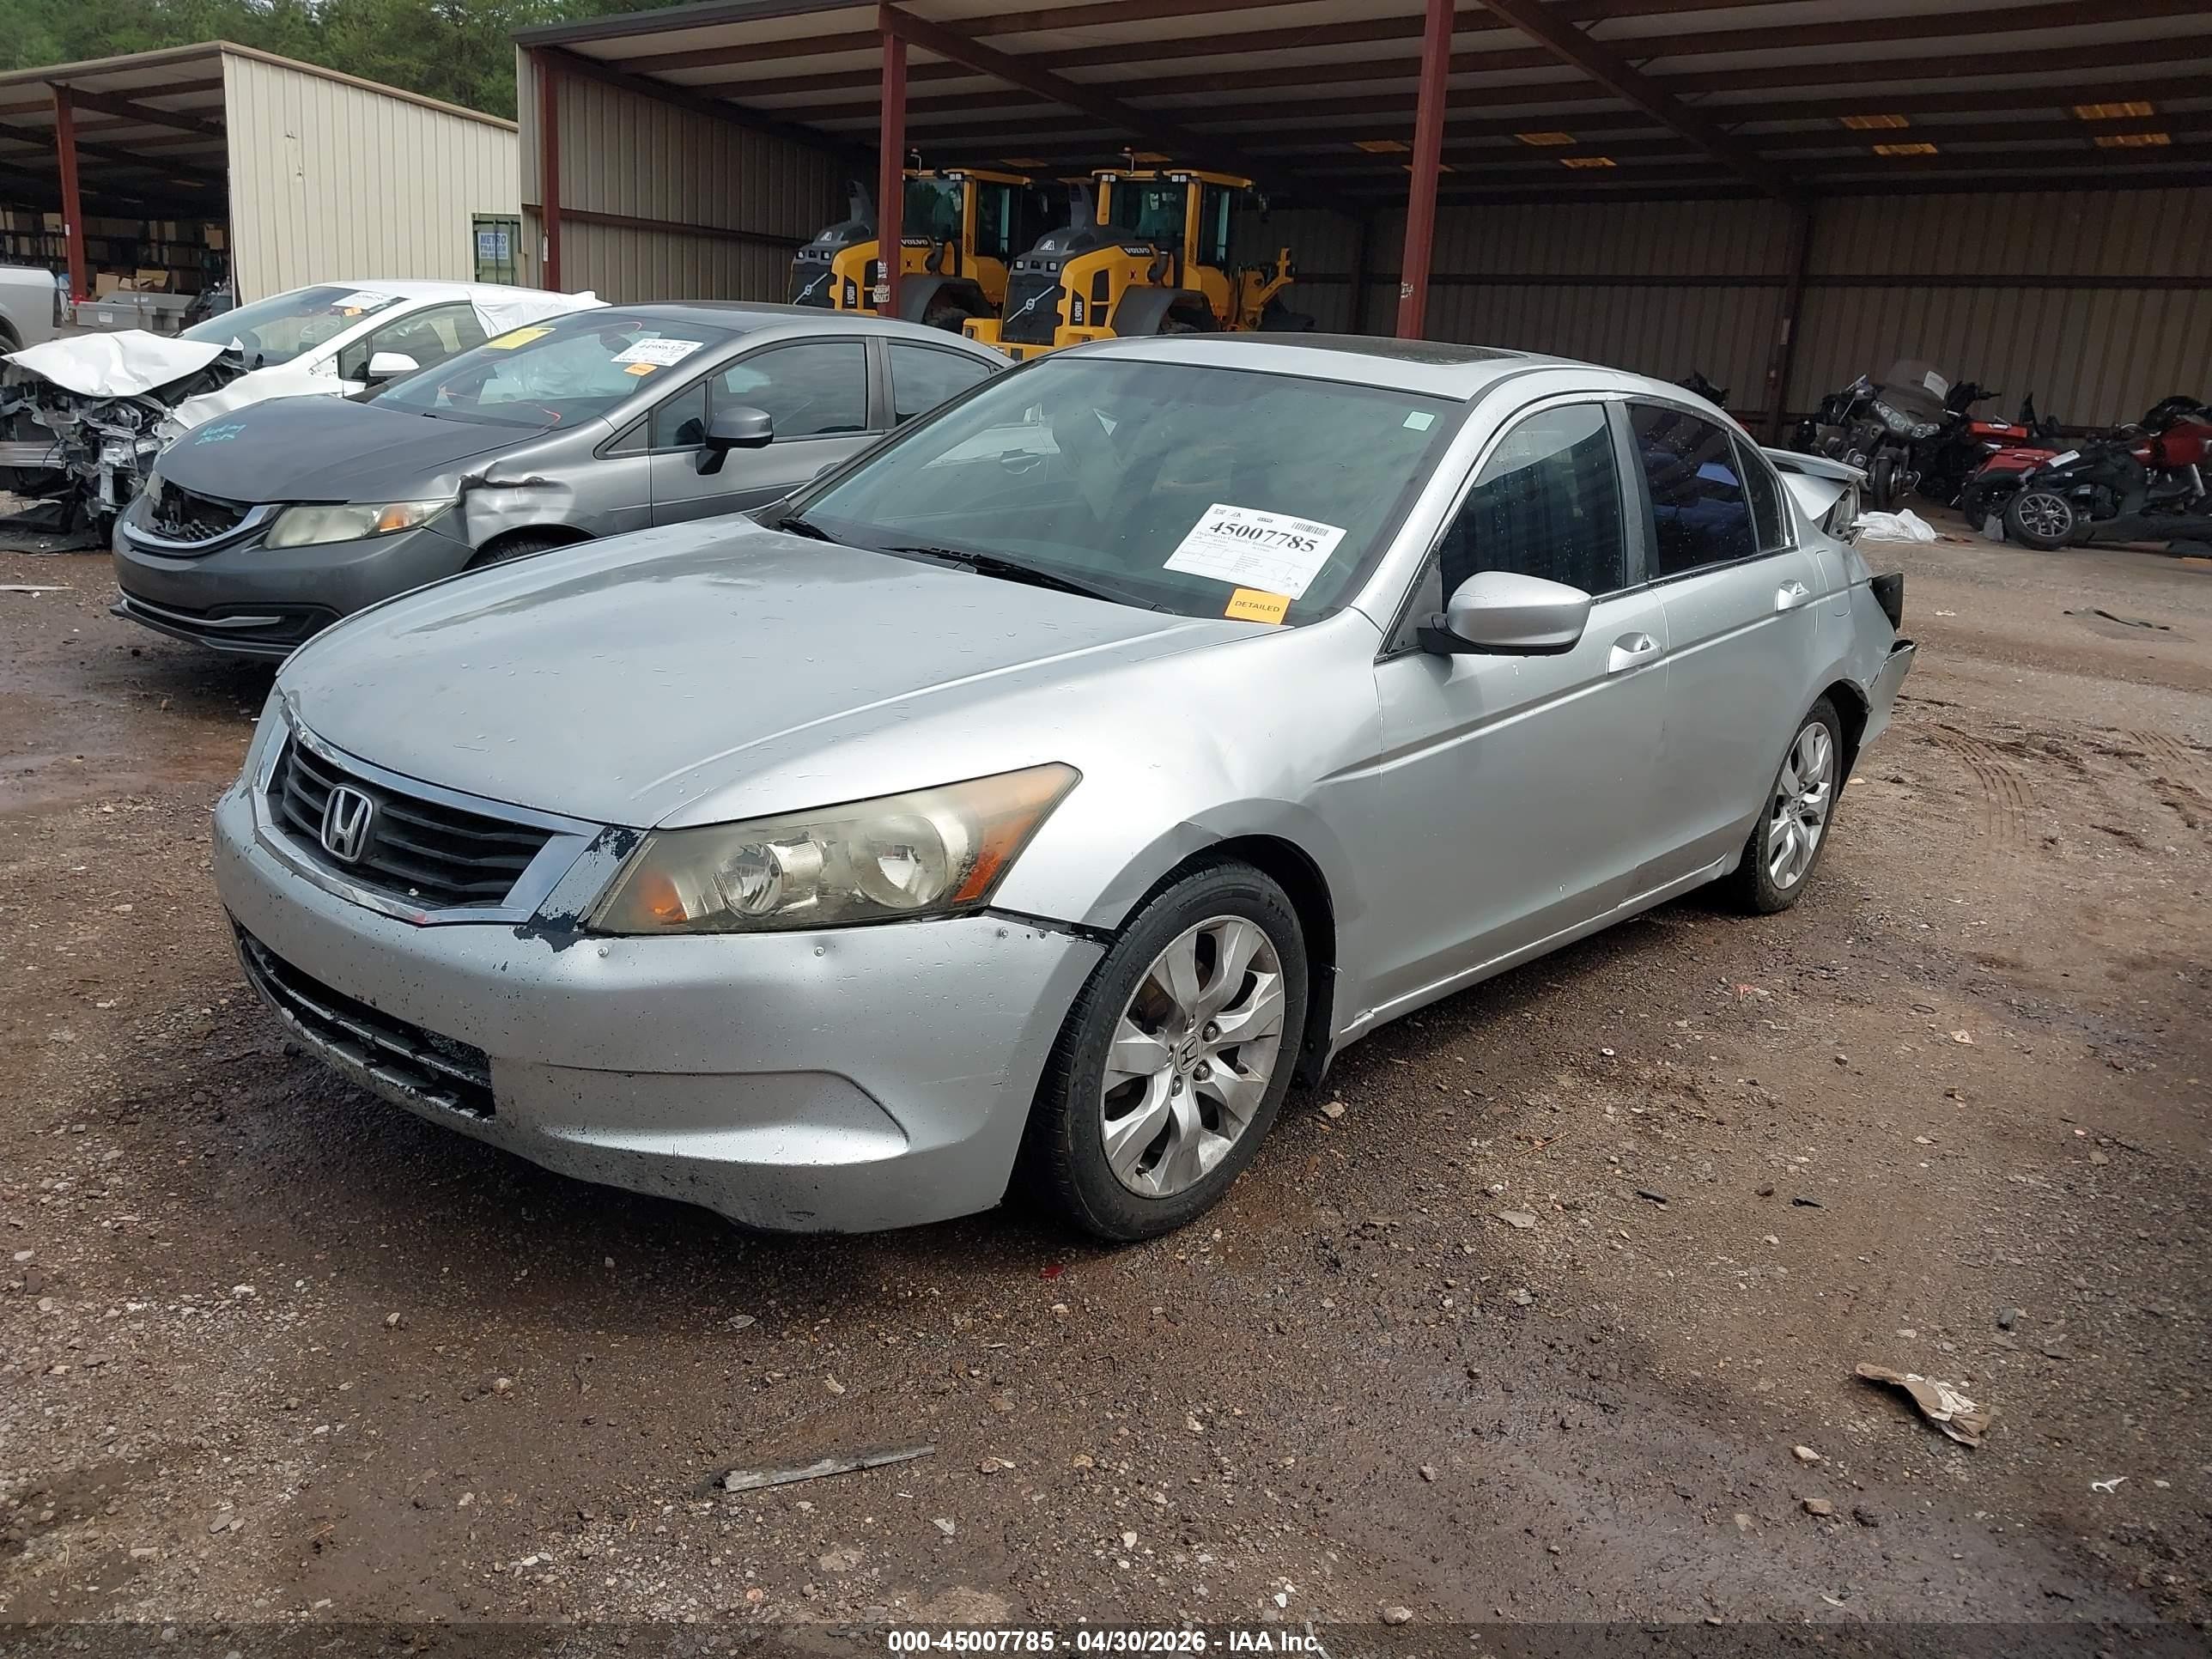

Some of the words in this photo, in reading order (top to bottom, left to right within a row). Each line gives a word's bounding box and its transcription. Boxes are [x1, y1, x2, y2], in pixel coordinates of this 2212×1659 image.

[1074, 301, 1083, 322] L90H
[1209, 521, 1319, 552] 45007785
[1234, 600, 1280, 612] DETAILED
